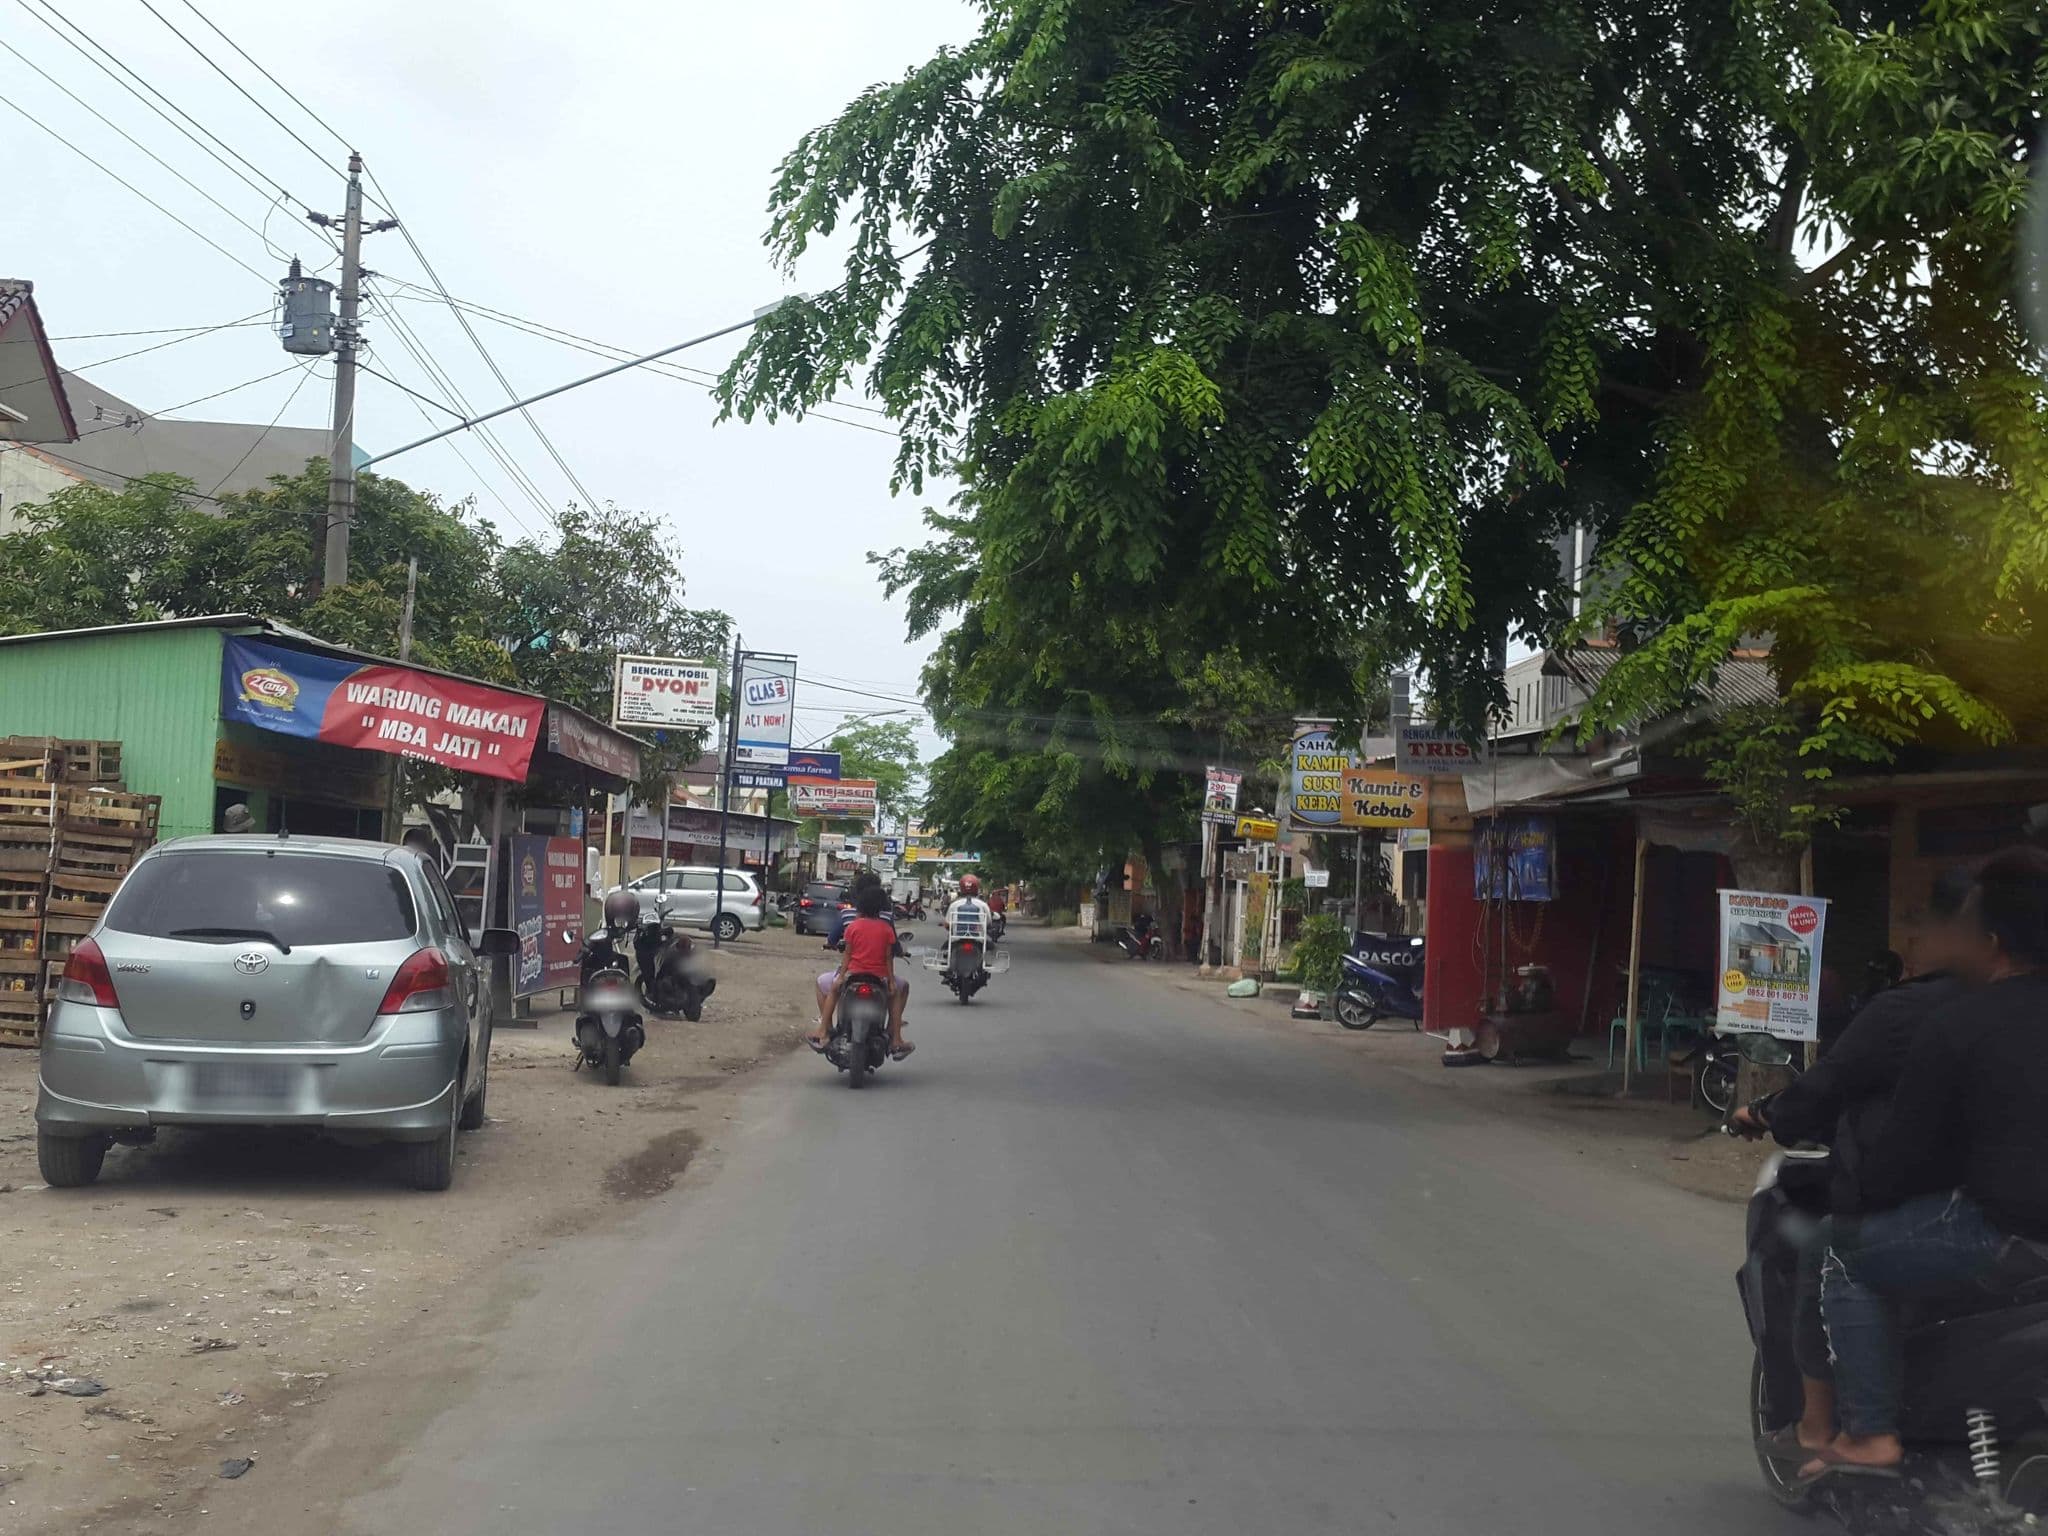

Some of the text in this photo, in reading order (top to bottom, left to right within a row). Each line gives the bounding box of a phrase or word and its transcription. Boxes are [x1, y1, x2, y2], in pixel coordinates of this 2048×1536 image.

[631, 666, 709, 680] BENGKEL MOBIL
[347, 683, 442, 719] WARUNG
[446, 703, 528, 738] MAKAN
[745, 713, 785, 728] ACT NOW!
[378, 719, 427, 748] MBA
[433, 733, 482, 760] JATI
[1408, 742, 1469, 757] TRIS
[807, 765, 833, 775] farma
[1297, 755, 1350, 772] KAMIR
[1210, 783, 1226, 792] 290
[1303, 776, 1341, 792] SUSU
[1348, 778, 1422, 798] Kamir &
[1297, 795, 1341, 811] KEBA
[1353, 800, 1415, 818] Kebab
